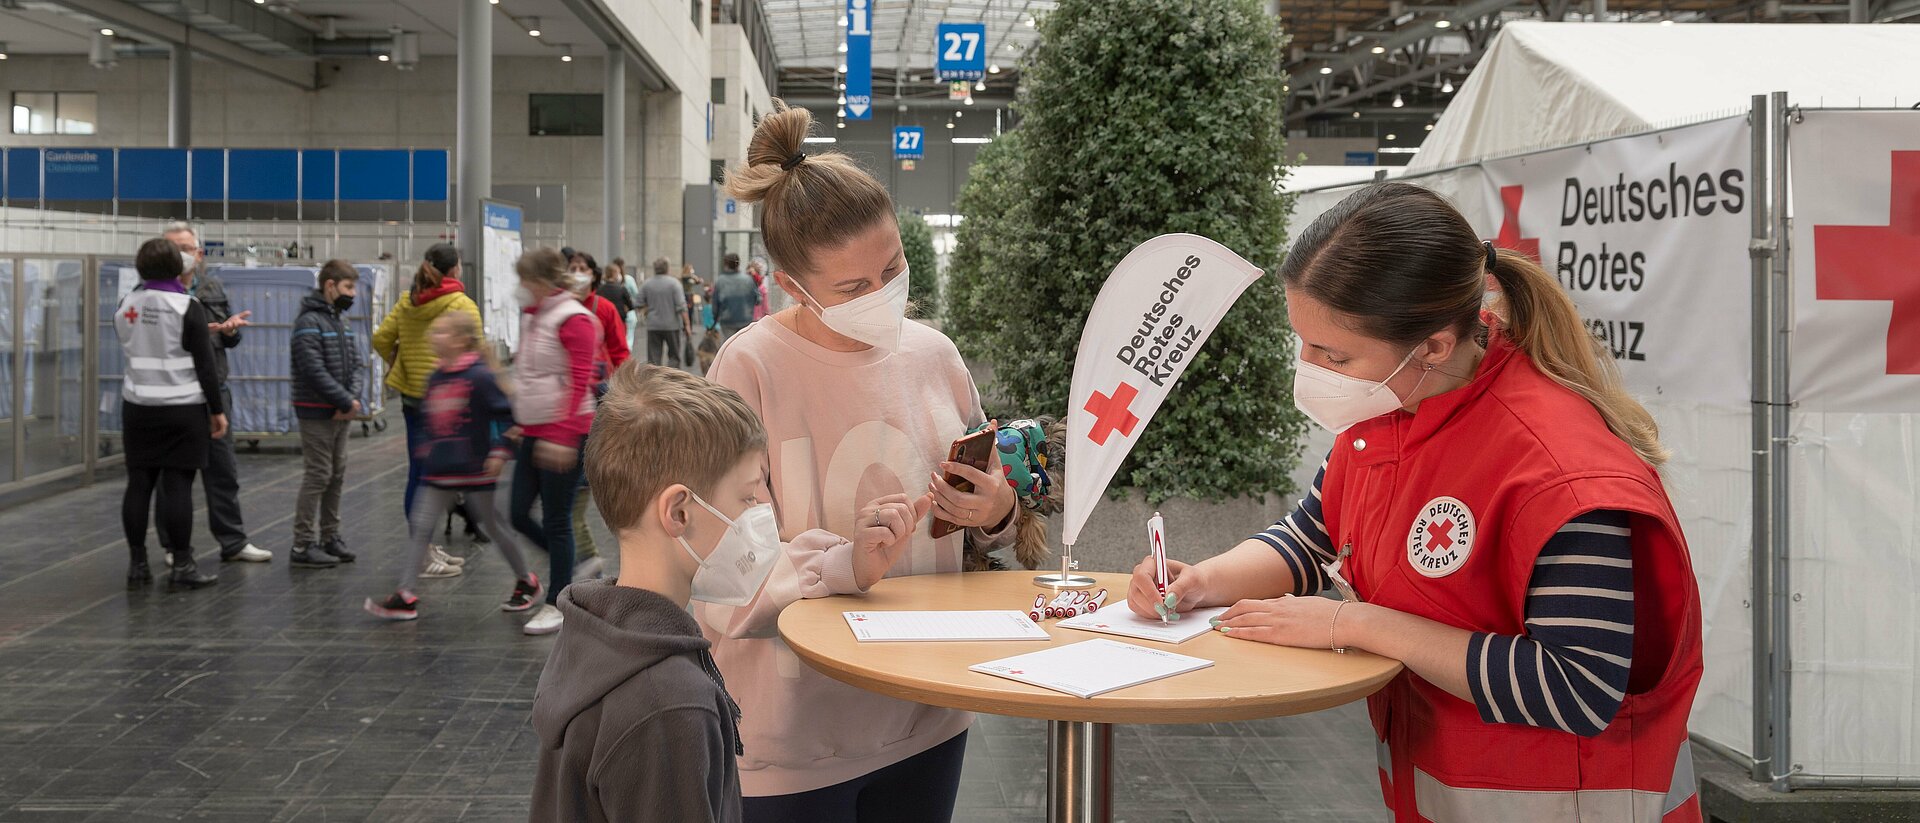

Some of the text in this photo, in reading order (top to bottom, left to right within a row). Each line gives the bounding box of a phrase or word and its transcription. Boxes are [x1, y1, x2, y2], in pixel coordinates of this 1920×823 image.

[944, 32, 980, 61] 27
[847, 95, 870, 105] INFO
[899, 131, 921, 150] 27
[1561, 162, 1744, 226] Deutsches
[1558, 241, 1646, 291] Rotes
[1116, 255, 1201, 366] Deutsches
[1133, 313, 1184, 376] Rotes
[1149, 324, 1202, 387] Kreuz
[1413, 519, 1458, 569] ROTES KREUZ
[1429, 502, 1469, 546] DEUTSCHES
